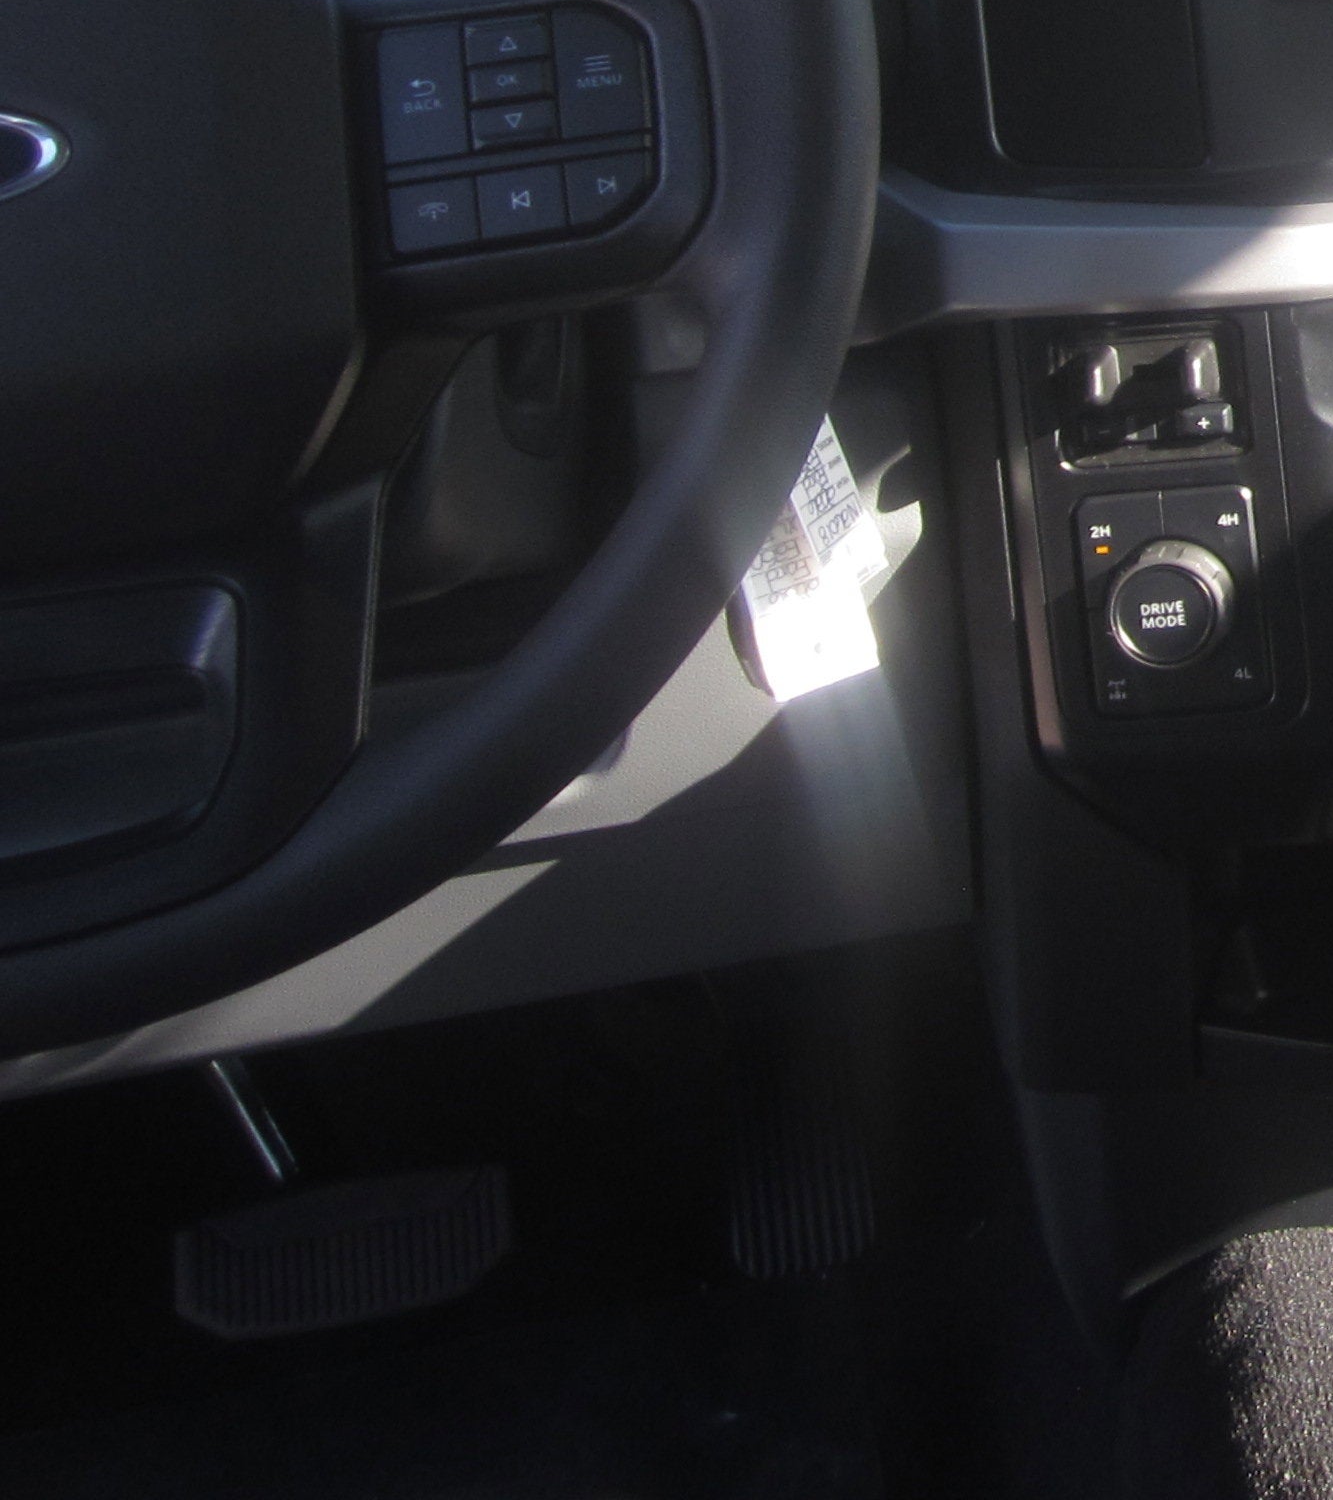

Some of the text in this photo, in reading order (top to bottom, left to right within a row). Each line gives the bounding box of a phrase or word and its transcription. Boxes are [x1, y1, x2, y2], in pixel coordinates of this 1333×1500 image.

[577, 74, 623, 90] MENU
[403, 99, 442, 114] BACK
[1217, 513, 1239, 527] 4H
[1089, 524, 1112, 539] 2H
[1140, 600, 1185, 615] DRIVE
[1141, 614, 1187, 629] MODE
[1234, 667, 1252, 680] 4L
